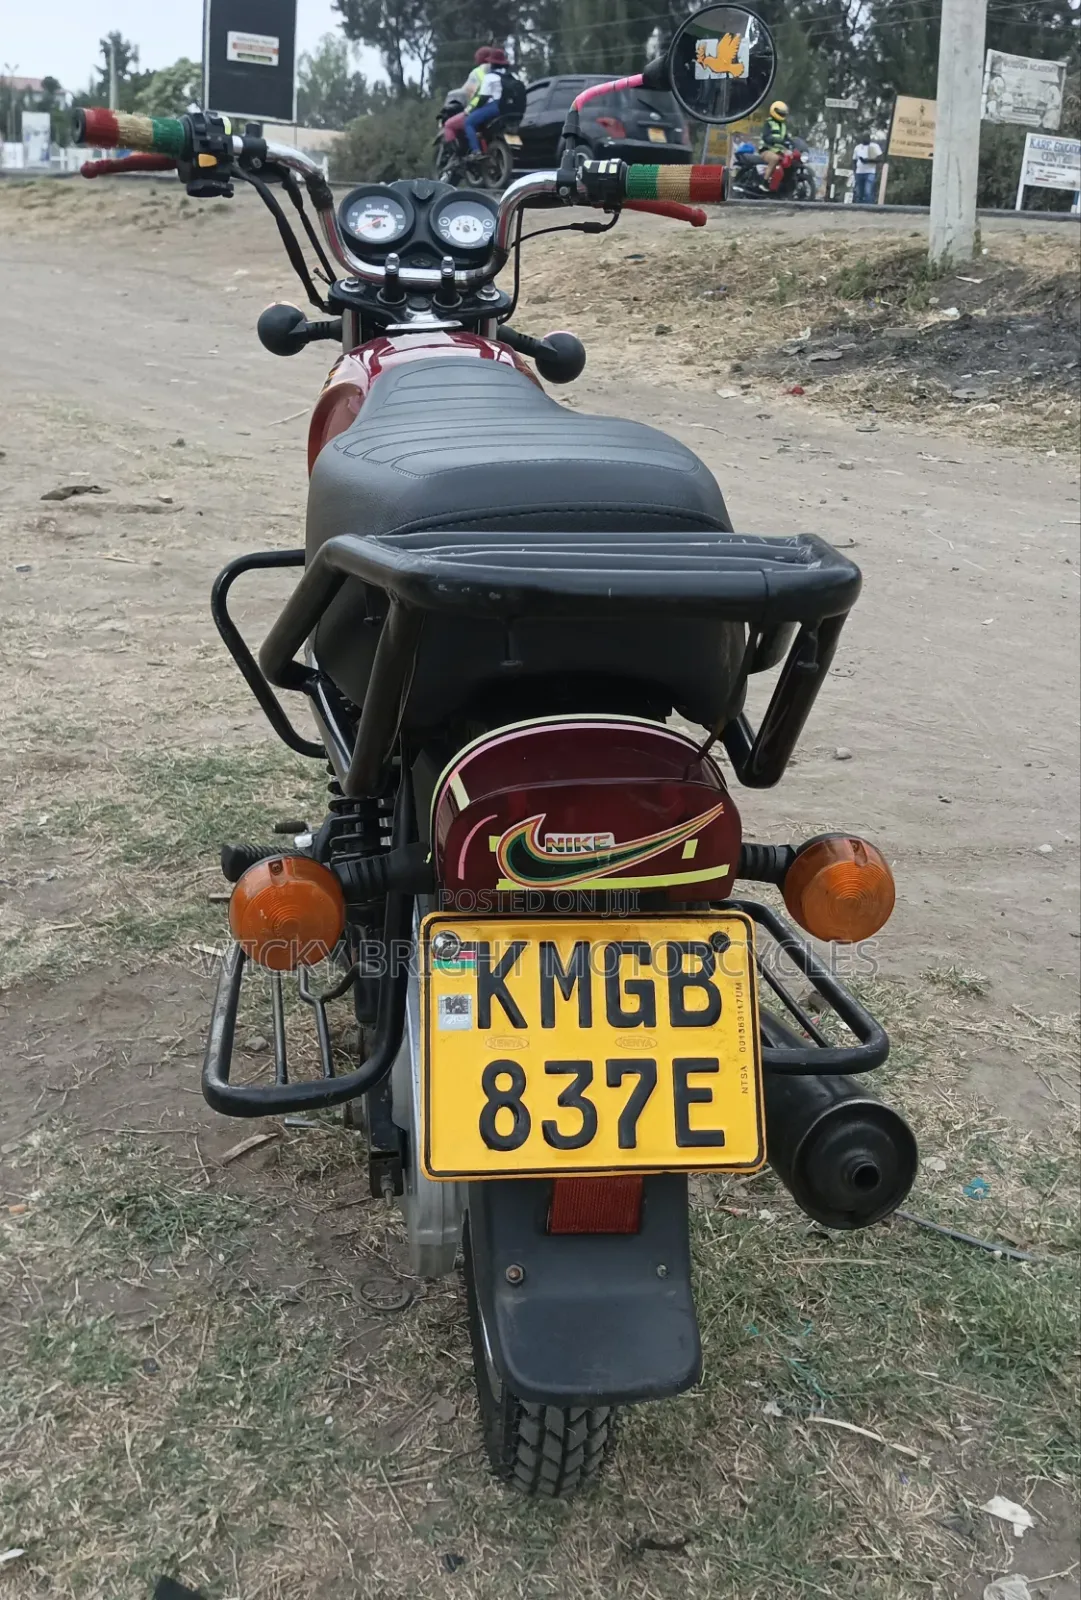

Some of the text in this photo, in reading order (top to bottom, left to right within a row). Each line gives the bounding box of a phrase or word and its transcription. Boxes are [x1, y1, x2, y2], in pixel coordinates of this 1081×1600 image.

[545, 834, 611, 853] NIKE
[477, 940, 723, 1029] KMGB
[478, 1057, 726, 1152] 837E
[740, 1065, 749, 1095] NTSA
